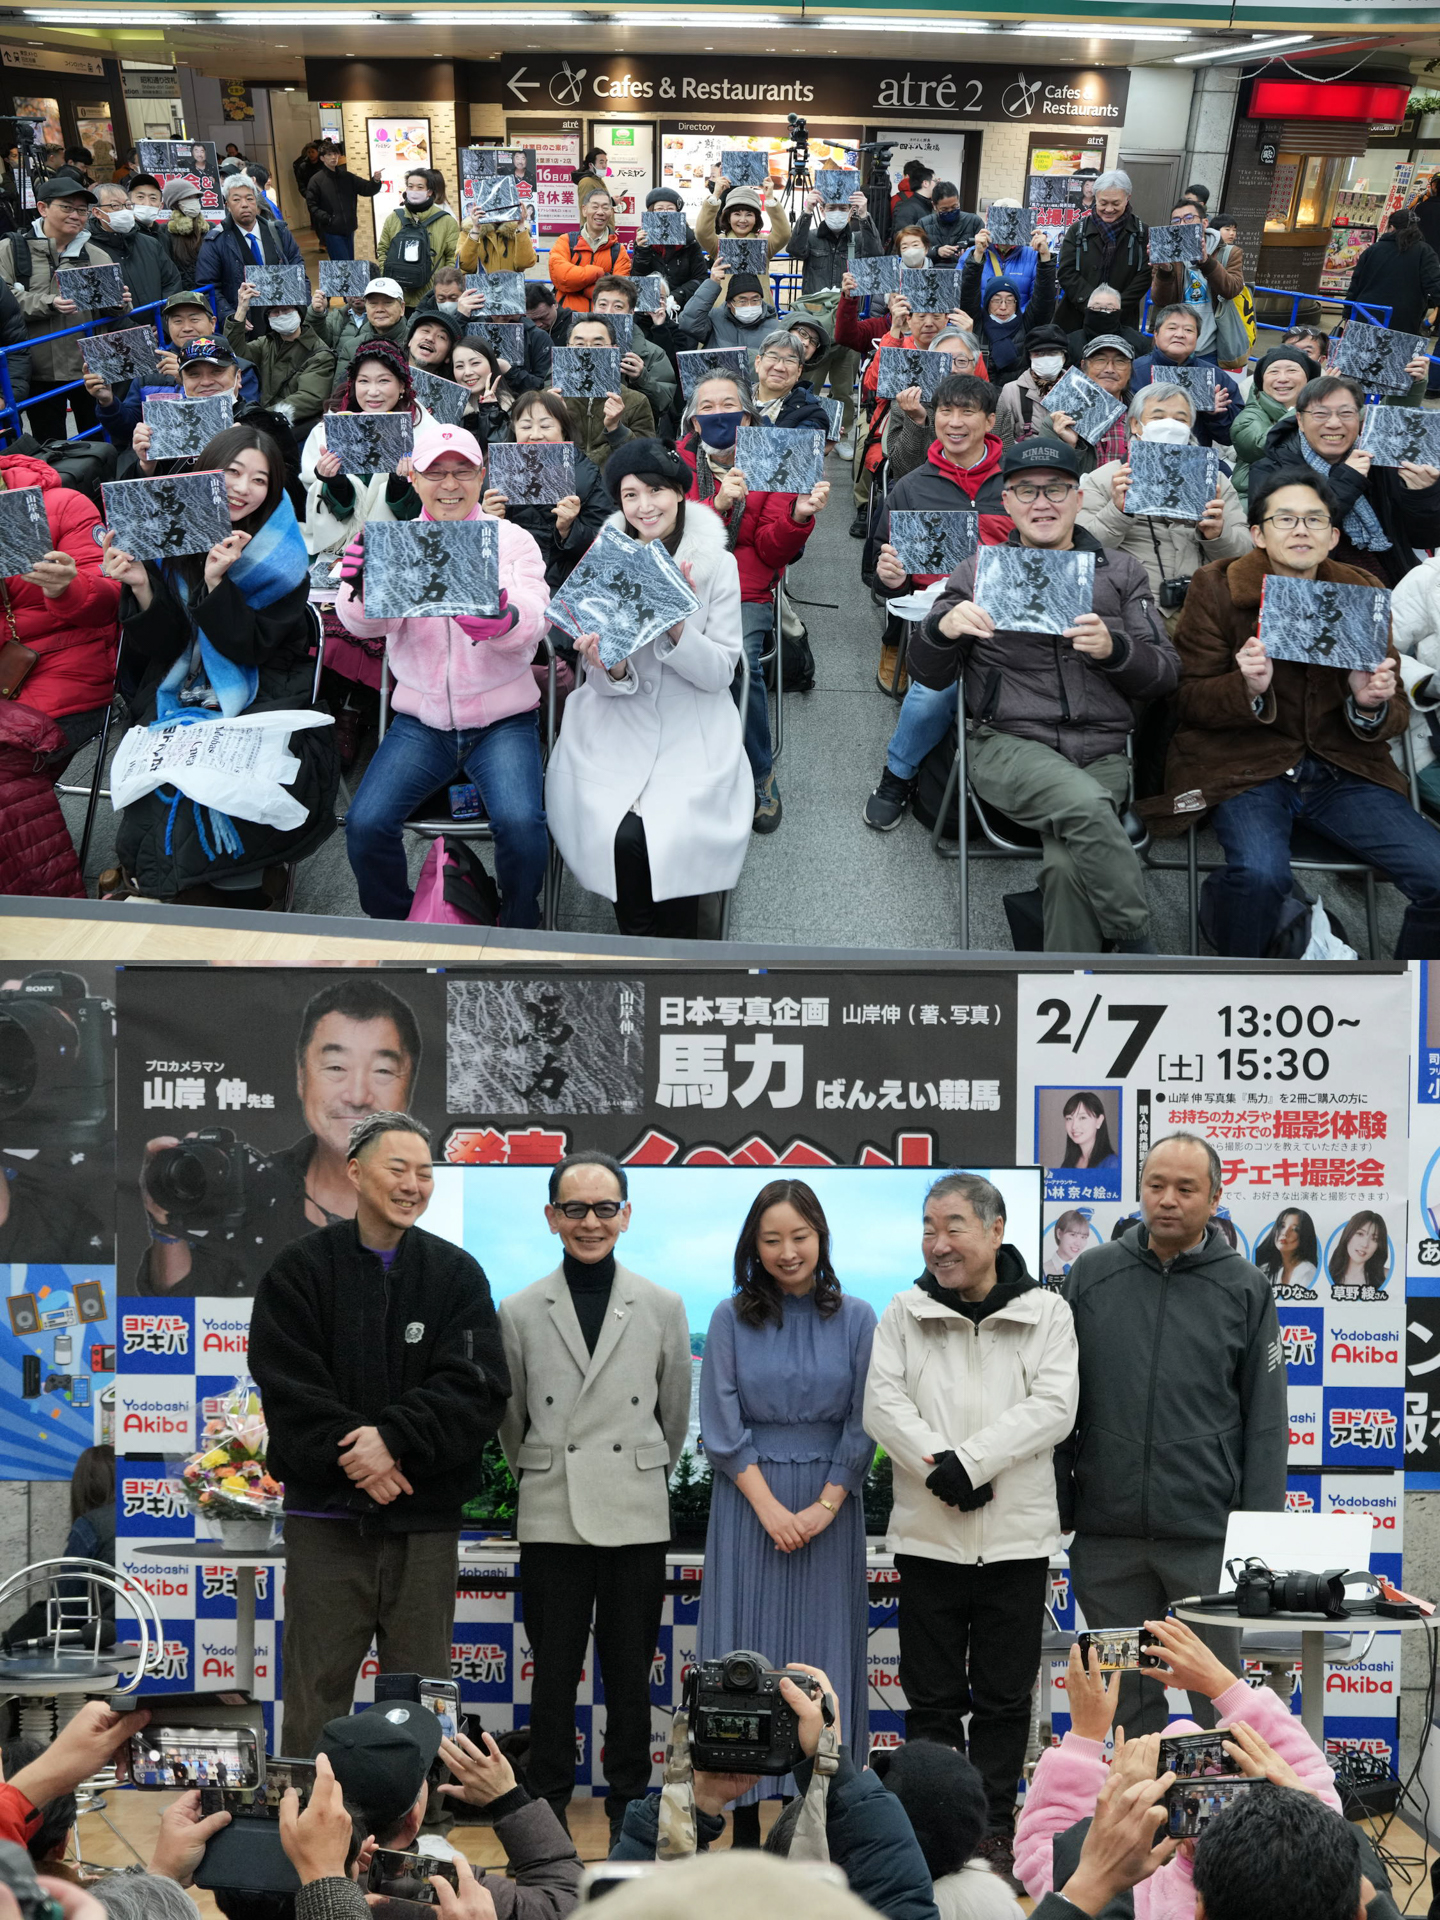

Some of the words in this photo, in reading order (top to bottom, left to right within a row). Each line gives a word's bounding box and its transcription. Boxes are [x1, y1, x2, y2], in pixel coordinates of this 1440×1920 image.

[140, 76, 177, 84] 昭和通り改札
[593, 75, 654, 101] Cafes
[659, 77, 677, 99] &
[682, 77, 814, 103] Restaurants
[877, 70, 958, 109] atré
[959, 79, 983, 113] 2
[1044, 84, 1080, 101] Cafes
[1042, 100, 1119, 118] Restaurants
[562, 120, 579, 128] atré
[678, 122, 716, 132] Directory
[1086, 136, 1104, 145] atré
[617, 170, 646, 178] バーミヤン
[1022, 448, 1059, 460] KINASHI
[482, 528, 492, 559] 山岸伸
[1373, 594, 1384, 624] 山岸伸
[619, 991, 634, 1035] 山岸伸
[660, 996, 829, 1027] 日本写真企画
[1036, 994, 1168, 1079] 2/7
[145, 1060, 225, 1073] プロカメラマン
[655, 1033, 804, 1109] 馬力
[816, 1079, 1001, 1112] ばんえい競馬
[1217, 1048, 1330, 1081] 15:30
[143, 1077, 206, 1110] 山岸
[1168, 1093, 1189, 1104] 山岸
[1169, 1110, 1272, 1124] お持ちのカメラや
[1273, 1110, 1388, 1139] 撮影体験
[1205, 1126, 1272, 1139] スマホでの
[1221, 1158, 1385, 1187] チェキ撮影会
[1068, 1186, 1119, 1199] 奈々絵さん
[1333, 1286, 1360, 1300] 草野
[124, 1317, 187, 1332] ヨドバシ
[124, 1334, 186, 1353] アキバ
[1330, 1329, 1399, 1341] Yodobashi
[1331, 1344, 1398, 1363] Akiba
[123, 1399, 189, 1411] Yodobashi
[124, 1414, 188, 1433] Akiba
[1332, 1411, 1396, 1425] ヨドバシ
[1332, 1428, 1395, 1446] アキバ
[124, 1497, 187, 1516] アキバ
[1328, 1494, 1396, 1507] Yodobashi
[123, 1562, 188, 1574] Yodobashi
[1326, 1674, 1392, 1694] Akiba
